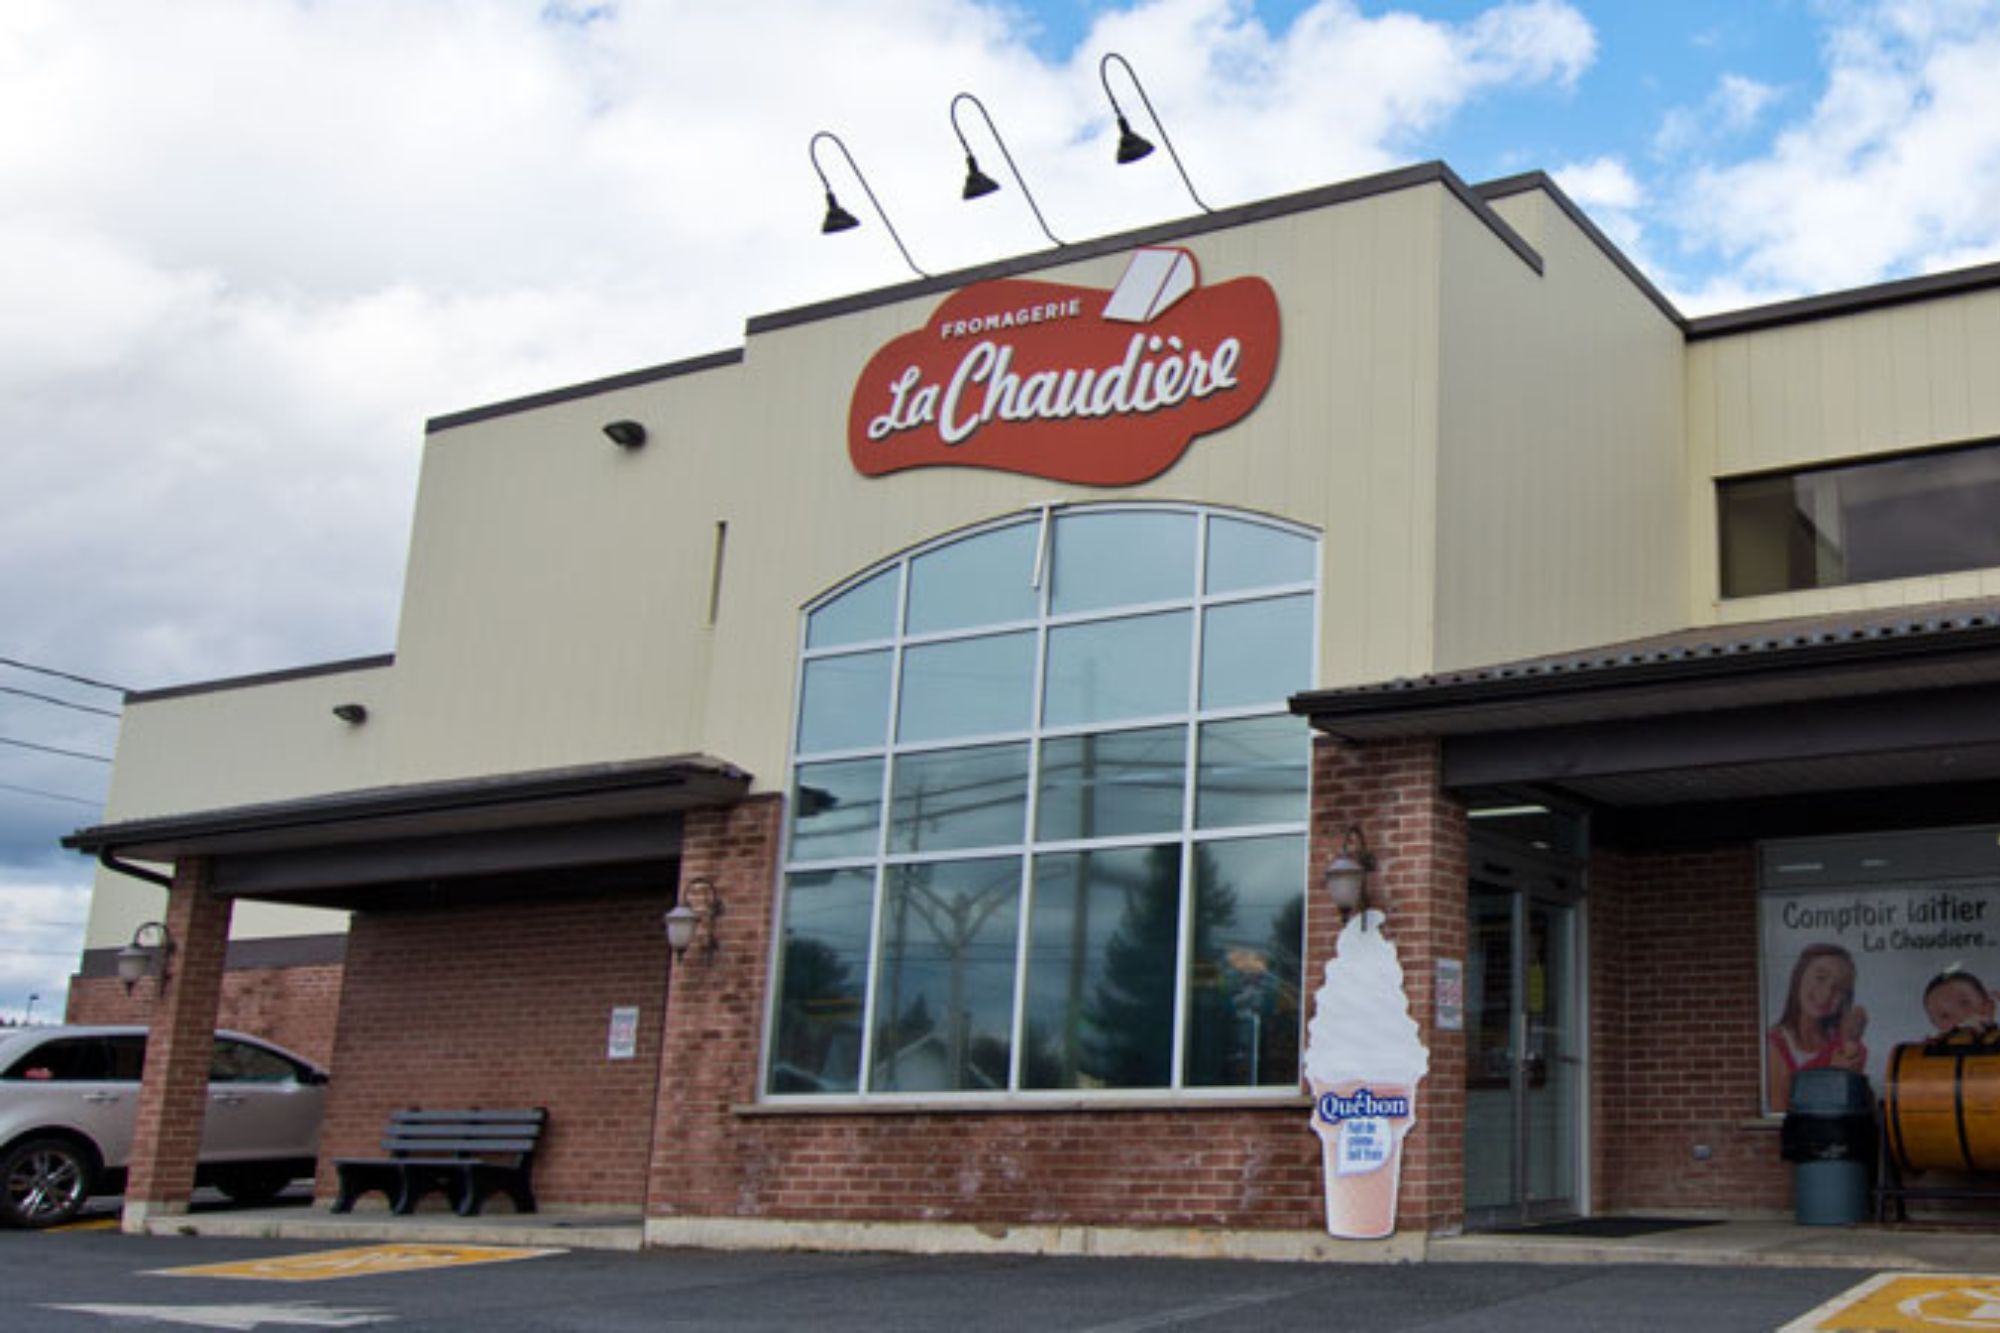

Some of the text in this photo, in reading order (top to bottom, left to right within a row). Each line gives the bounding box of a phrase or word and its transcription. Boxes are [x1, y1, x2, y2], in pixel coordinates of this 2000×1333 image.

[940, 300, 1080, 339] FROMAGERIE
[866, 331, 1241, 445] La Chaudière
[1782, 892, 1988, 935] Comptoir laitier
[1862, 933, 1886, 952] La
[1321, 1091, 1405, 1121] Québon
